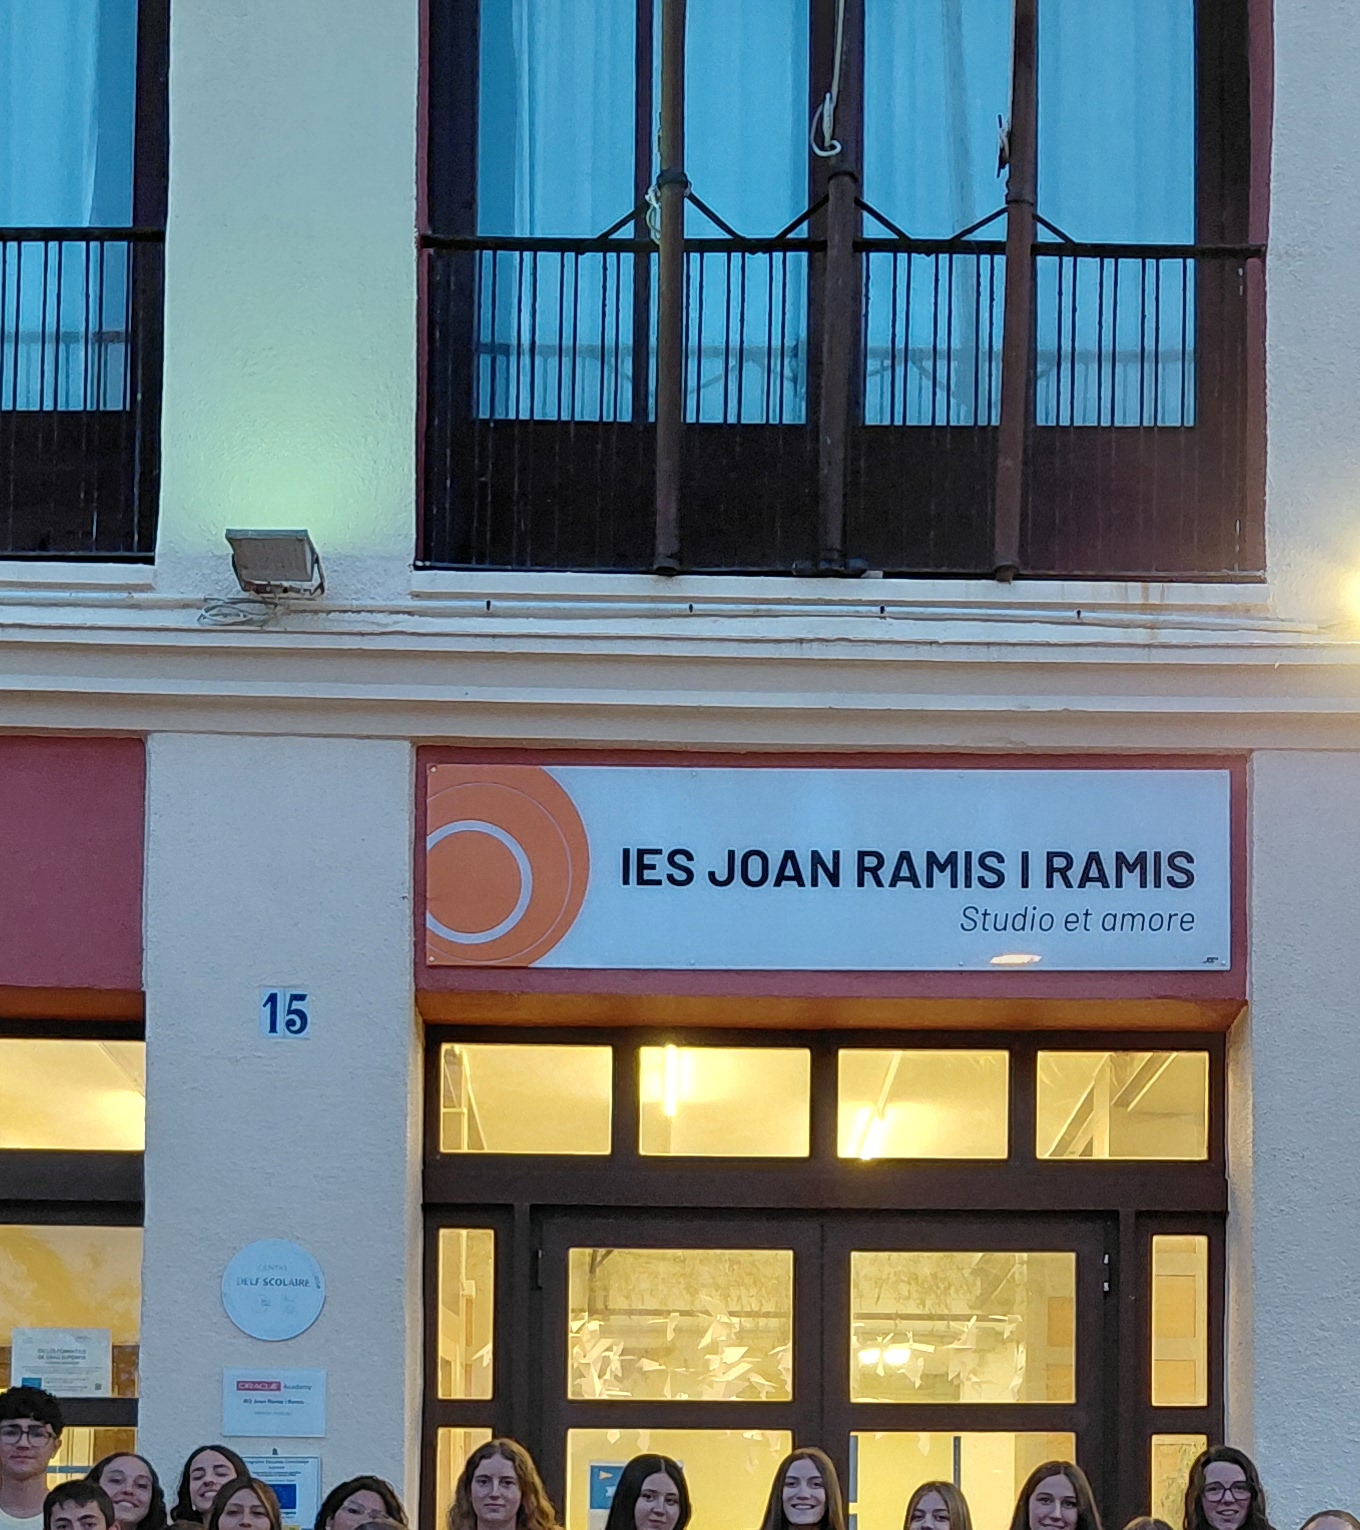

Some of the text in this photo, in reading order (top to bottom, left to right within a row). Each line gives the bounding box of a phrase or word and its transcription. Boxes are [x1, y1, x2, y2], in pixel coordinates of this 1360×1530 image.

[621, 847, 1196, 890] IES JOAN RAMIS I RAMIS
[960, 905, 1196, 934] Studio et amore
[262, 992, 308, 1034] 15
[263, 1277, 310, 1287] SCOLAIRE
